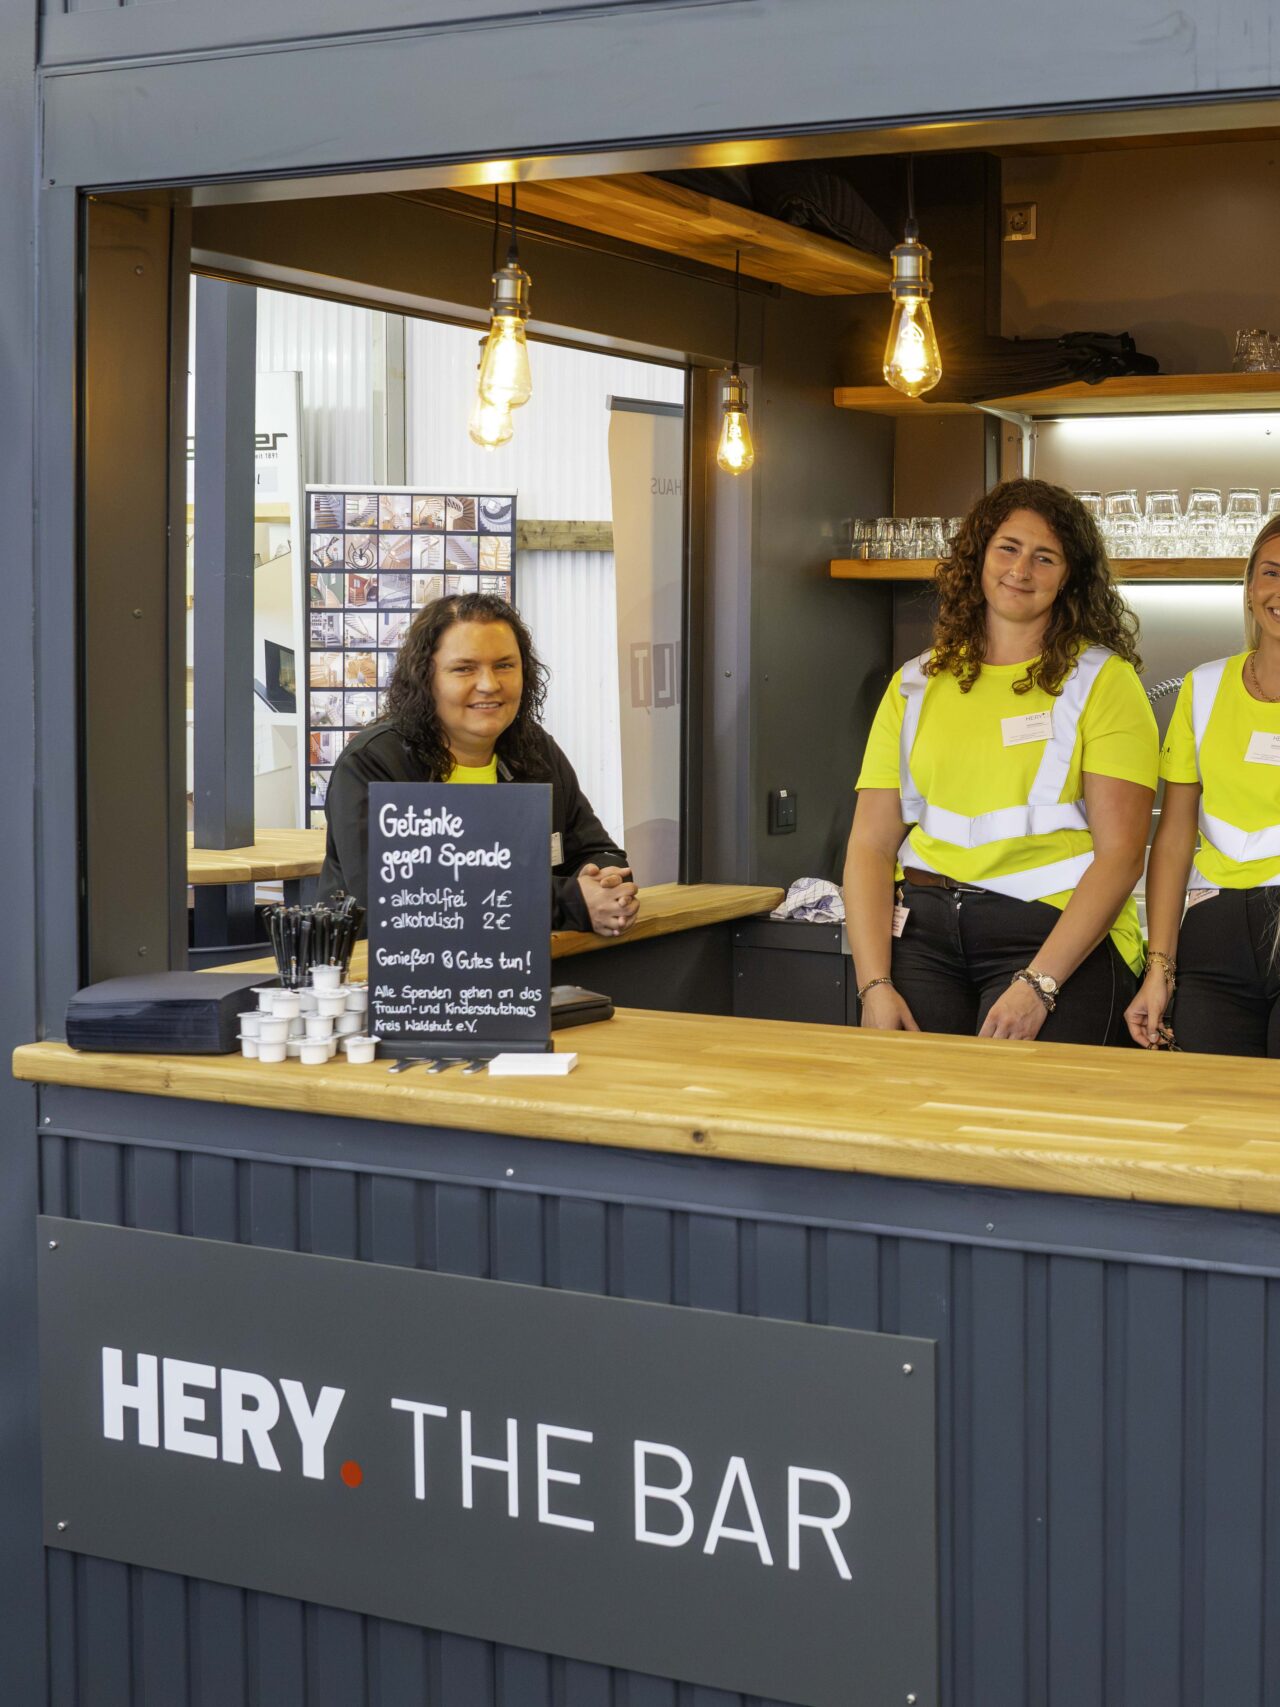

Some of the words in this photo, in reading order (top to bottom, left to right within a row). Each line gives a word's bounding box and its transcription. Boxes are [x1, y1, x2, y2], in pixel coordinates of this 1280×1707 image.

[379, 803, 465, 838] Getränke
[380, 844, 431, 883] gegen
[438, 841, 512, 881] Spende
[391, 887, 467, 911] alkoholfrei
[481, 890, 512, 908] 1€
[392, 913, 464, 930] alkoholisch
[483, 912, 511, 930] 2€
[376, 948, 434, 972] Genießen
[456, 952, 494, 971] Gutes
[375, 985, 397, 999] Alle
[401, 985, 452, 1004] Spenden
[459, 986, 492, 1007] gehen
[497, 988, 514, 1000] an
[519, 987, 543, 1001] das
[445, 1001, 537, 1018] Kinderschutzhaus
[375, 1019, 401, 1032] Kreis
[405, 1019, 454, 1033] Waldshut
[456, 1019, 478, 1033] e.V.
[390, 1397, 595, 1533] THE
[633, 1439, 853, 1581] BAR
